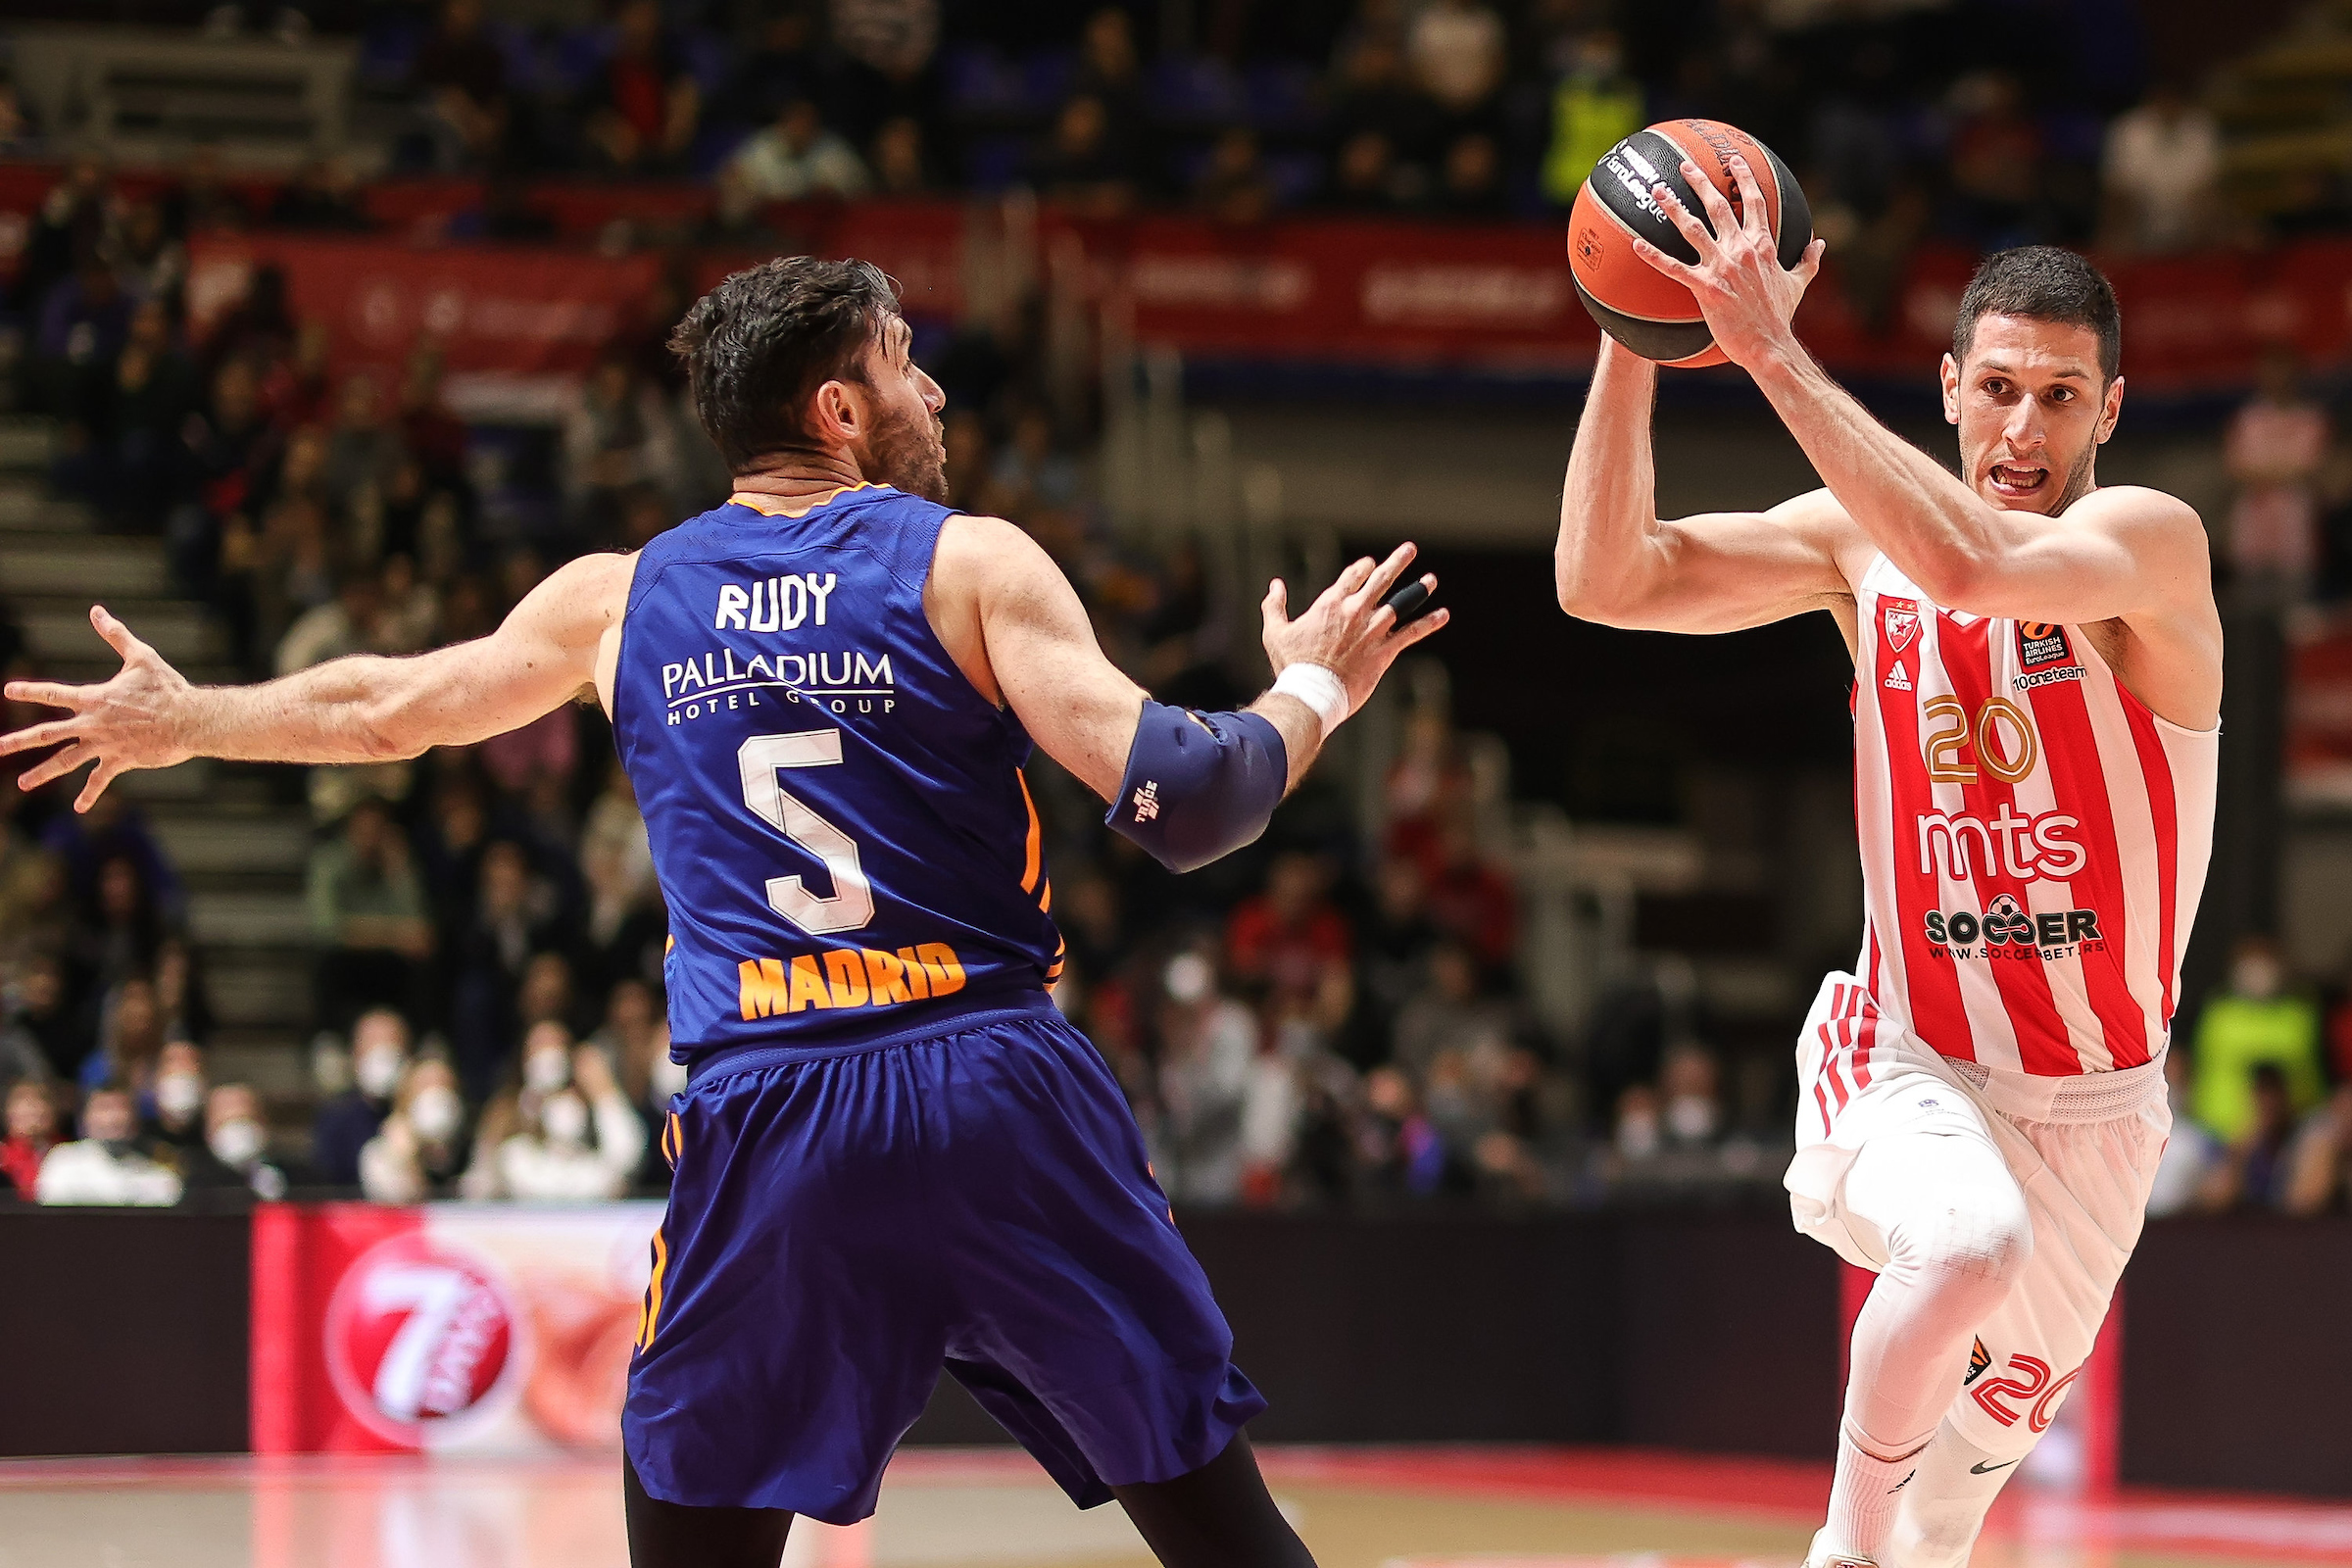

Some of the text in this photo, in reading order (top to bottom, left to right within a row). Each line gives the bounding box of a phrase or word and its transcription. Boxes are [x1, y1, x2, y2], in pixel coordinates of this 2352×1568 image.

[714, 571, 837, 633] RUDY
[2023, 636, 2061, 651] TURKISH
[2025, 643, 2063, 658] AIRLINES
[2026, 651, 2065, 664] EuroLeague
[662, 648, 895, 699] PALLADIUM
[666, 692, 760, 726] HOTEL
[1923, 693, 2037, 785] 20
[1134, 780, 1158, 823] TRACE
[737, 728, 876, 936] 5
[1916, 802, 2087, 879] mts
[1924, 908, 2104, 947] SOCCER
[737, 942, 967, 1021] MADRID
[361, 1264, 470, 1419] 7
